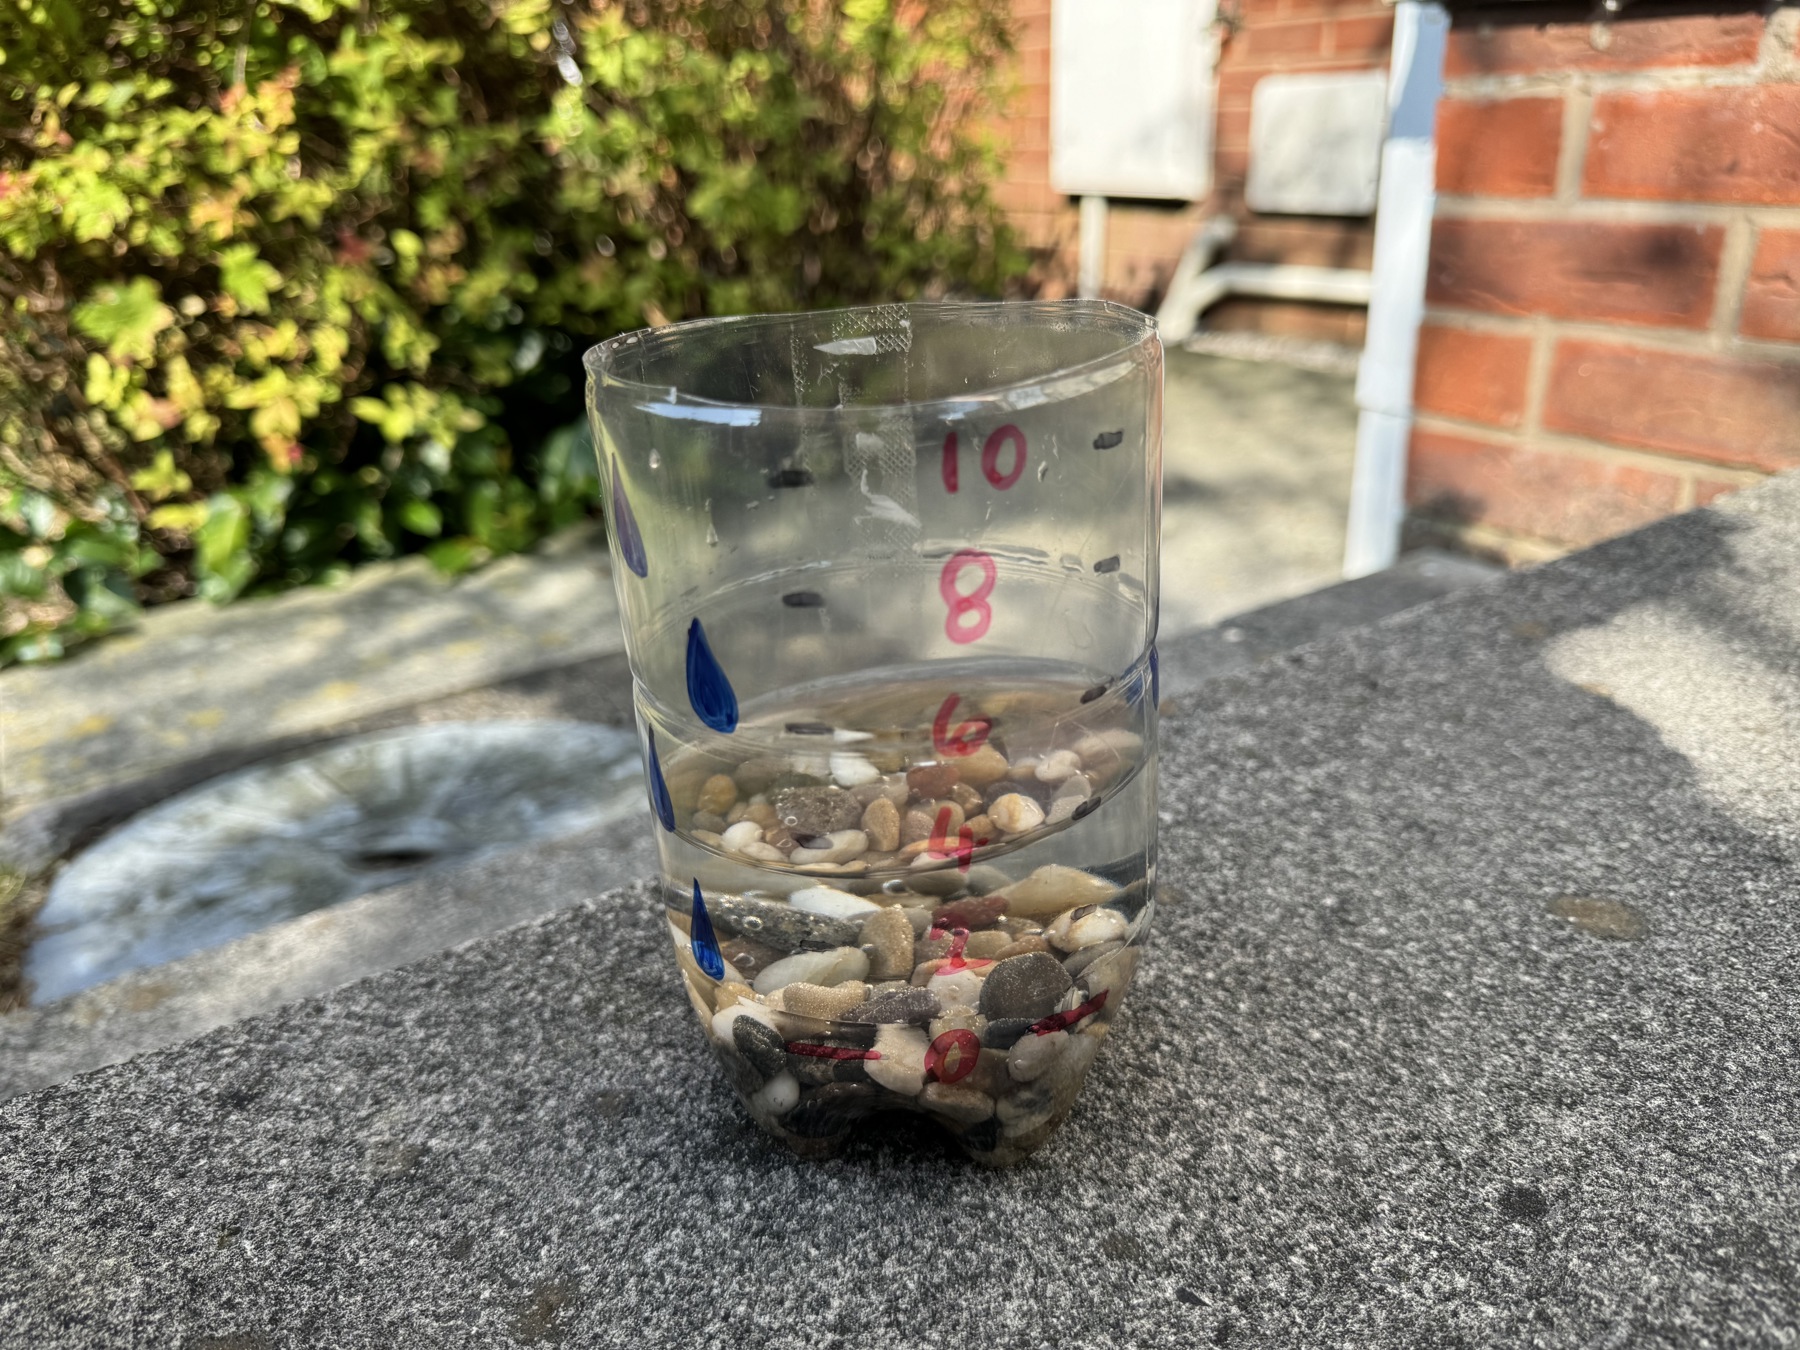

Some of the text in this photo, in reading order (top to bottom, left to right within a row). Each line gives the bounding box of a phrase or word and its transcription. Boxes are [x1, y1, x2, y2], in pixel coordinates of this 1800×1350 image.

[942, 424, 1027, 493] 10
[940, 549, 996, 644] 8
[932, 692, 992, 757] 6
[928, 806, 989, 872] 4
[929, 911, 994, 976] 2
[924, 1028, 980, 1084] 0
